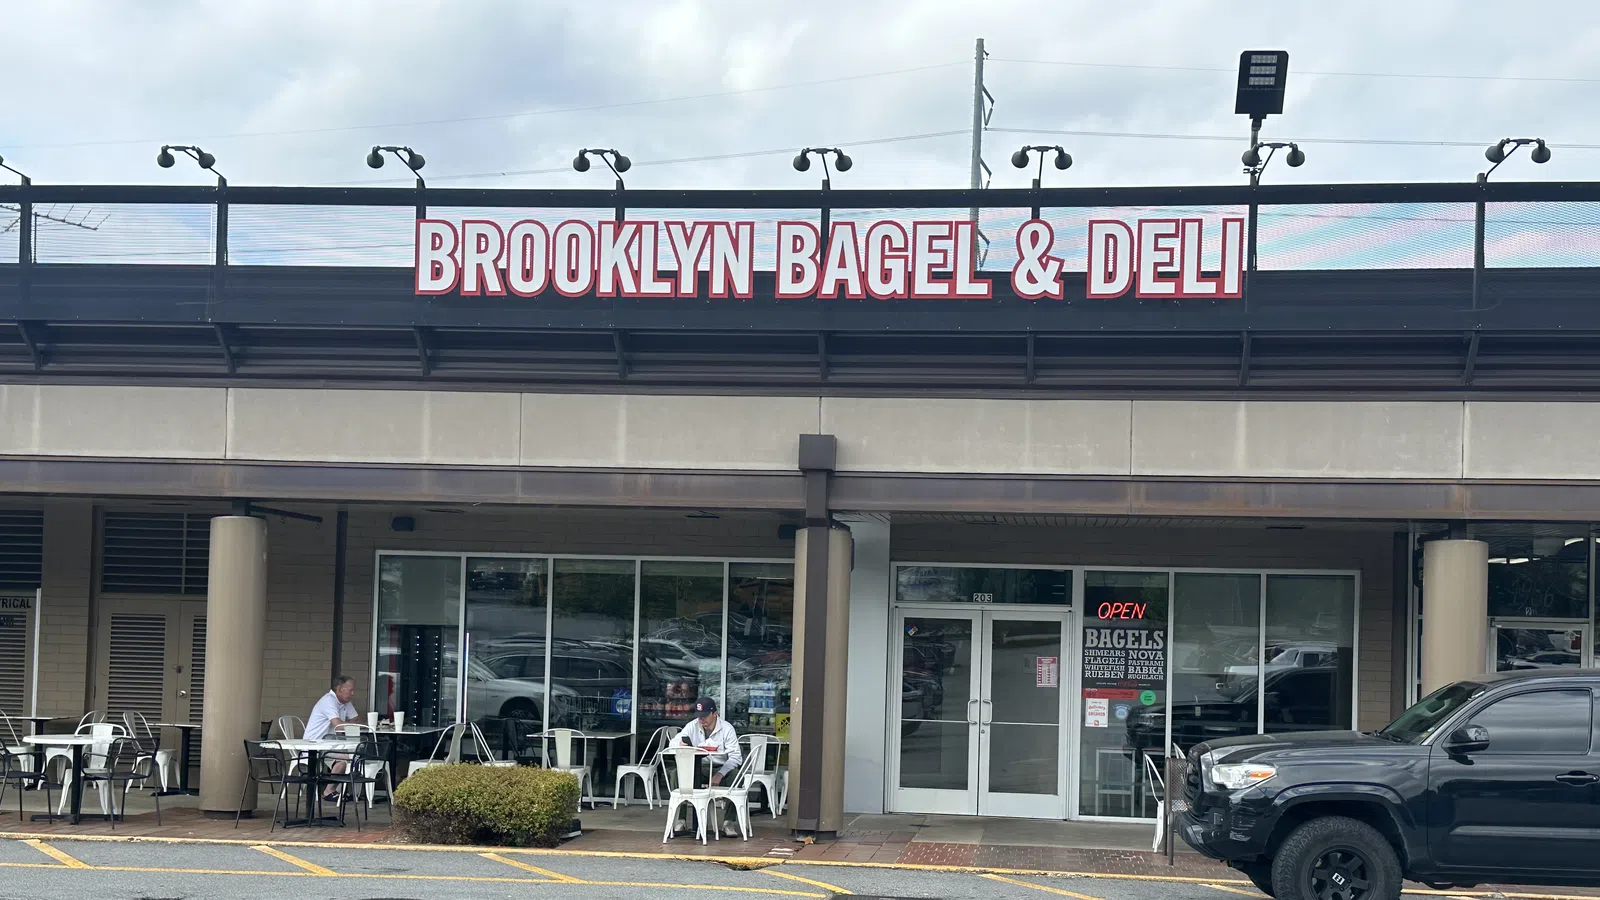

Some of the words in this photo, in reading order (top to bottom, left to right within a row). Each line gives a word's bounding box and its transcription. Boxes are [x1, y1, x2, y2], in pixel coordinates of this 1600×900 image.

[415, 219, 754, 298] BROOKLYN
[775, 220, 992, 299] BAGEL
[1011, 218, 1064, 300] &
[1086, 217, 1245, 298] DELI
[974, 593, 992, 602] 203
[0, 598, 31, 608] RICAL
[1098, 602, 1147, 619] OPEN
[1085, 628, 1164, 649] BAGELS
[1084, 649, 1126, 657] SHMEARS
[1128, 650, 1164, 660] NOVA
[1084, 656, 1126, 664] FLAGELS
[1084, 670, 1125, 678] RUEBEN
[1128, 666, 1164, 674] BABKA
